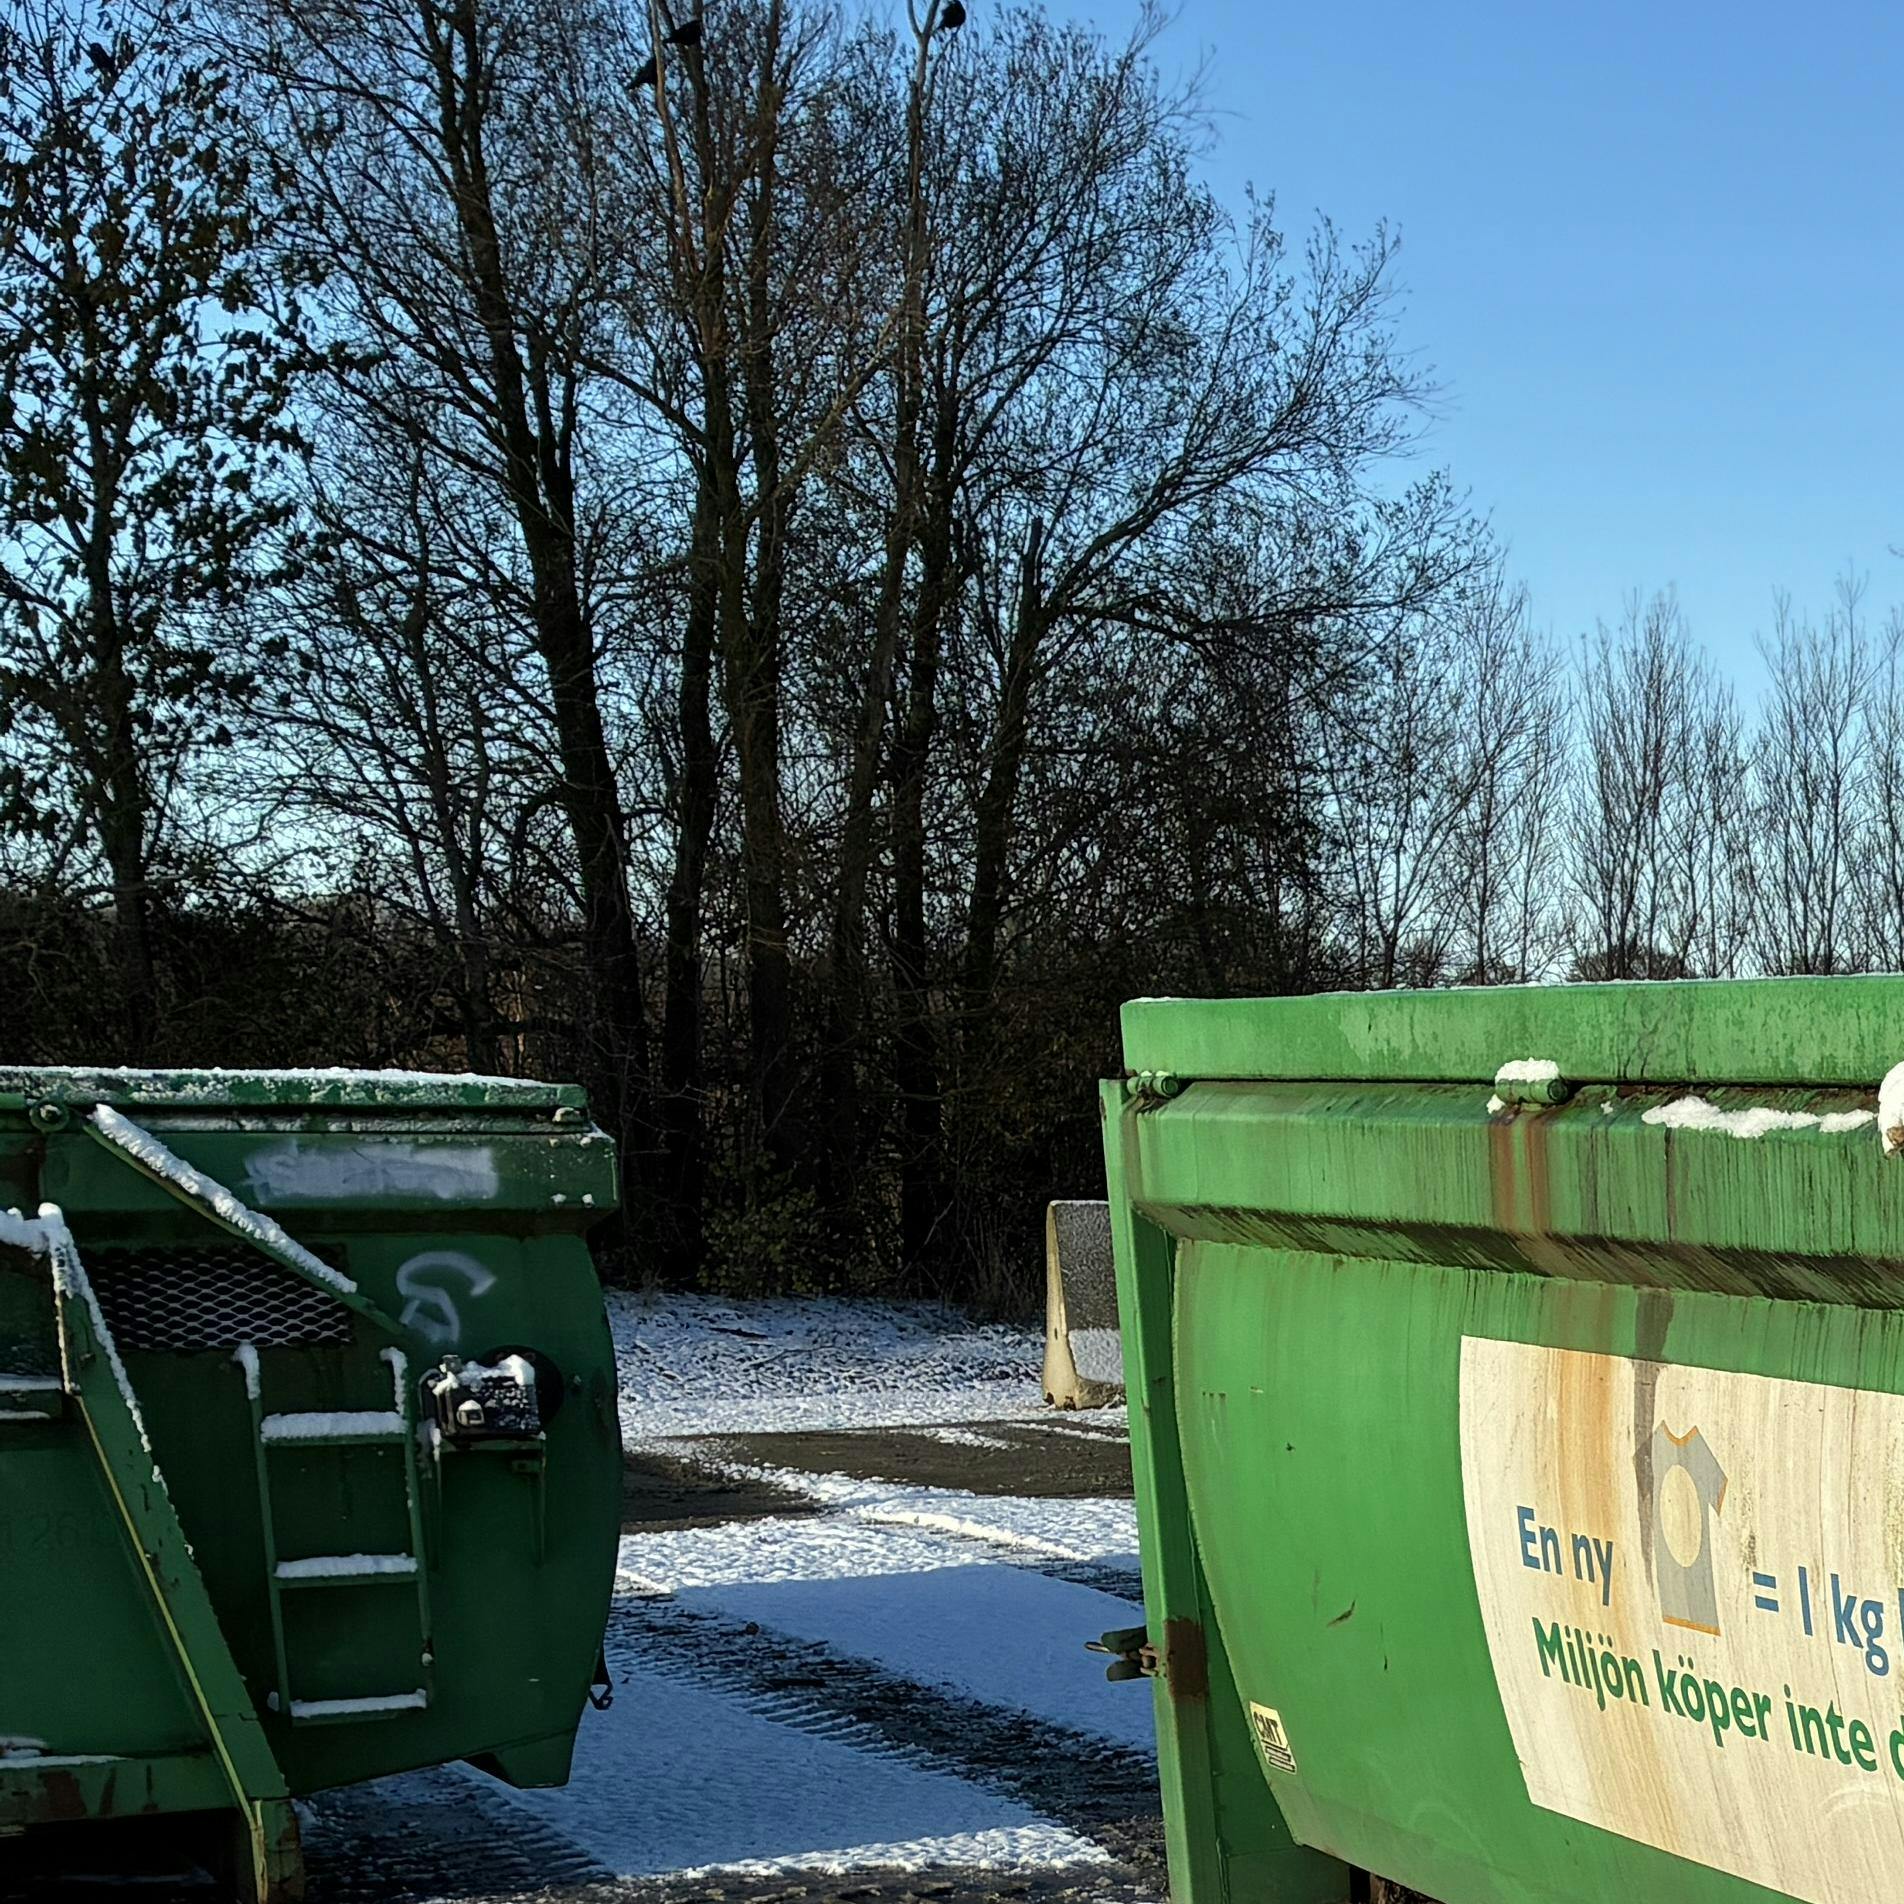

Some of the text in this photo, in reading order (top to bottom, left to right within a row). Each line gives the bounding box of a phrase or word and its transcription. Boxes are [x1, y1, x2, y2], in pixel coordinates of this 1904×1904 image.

[1516, 1504, 1563, 1576] En
[1571, 1532, 1613, 1607] ny
[1830, 1573, 1890, 1676] kg
[1532, 1616, 1650, 1712] Miljön
[1652, 1648, 1772, 1749] köper
[1783, 1683, 1878, 1772] inte
